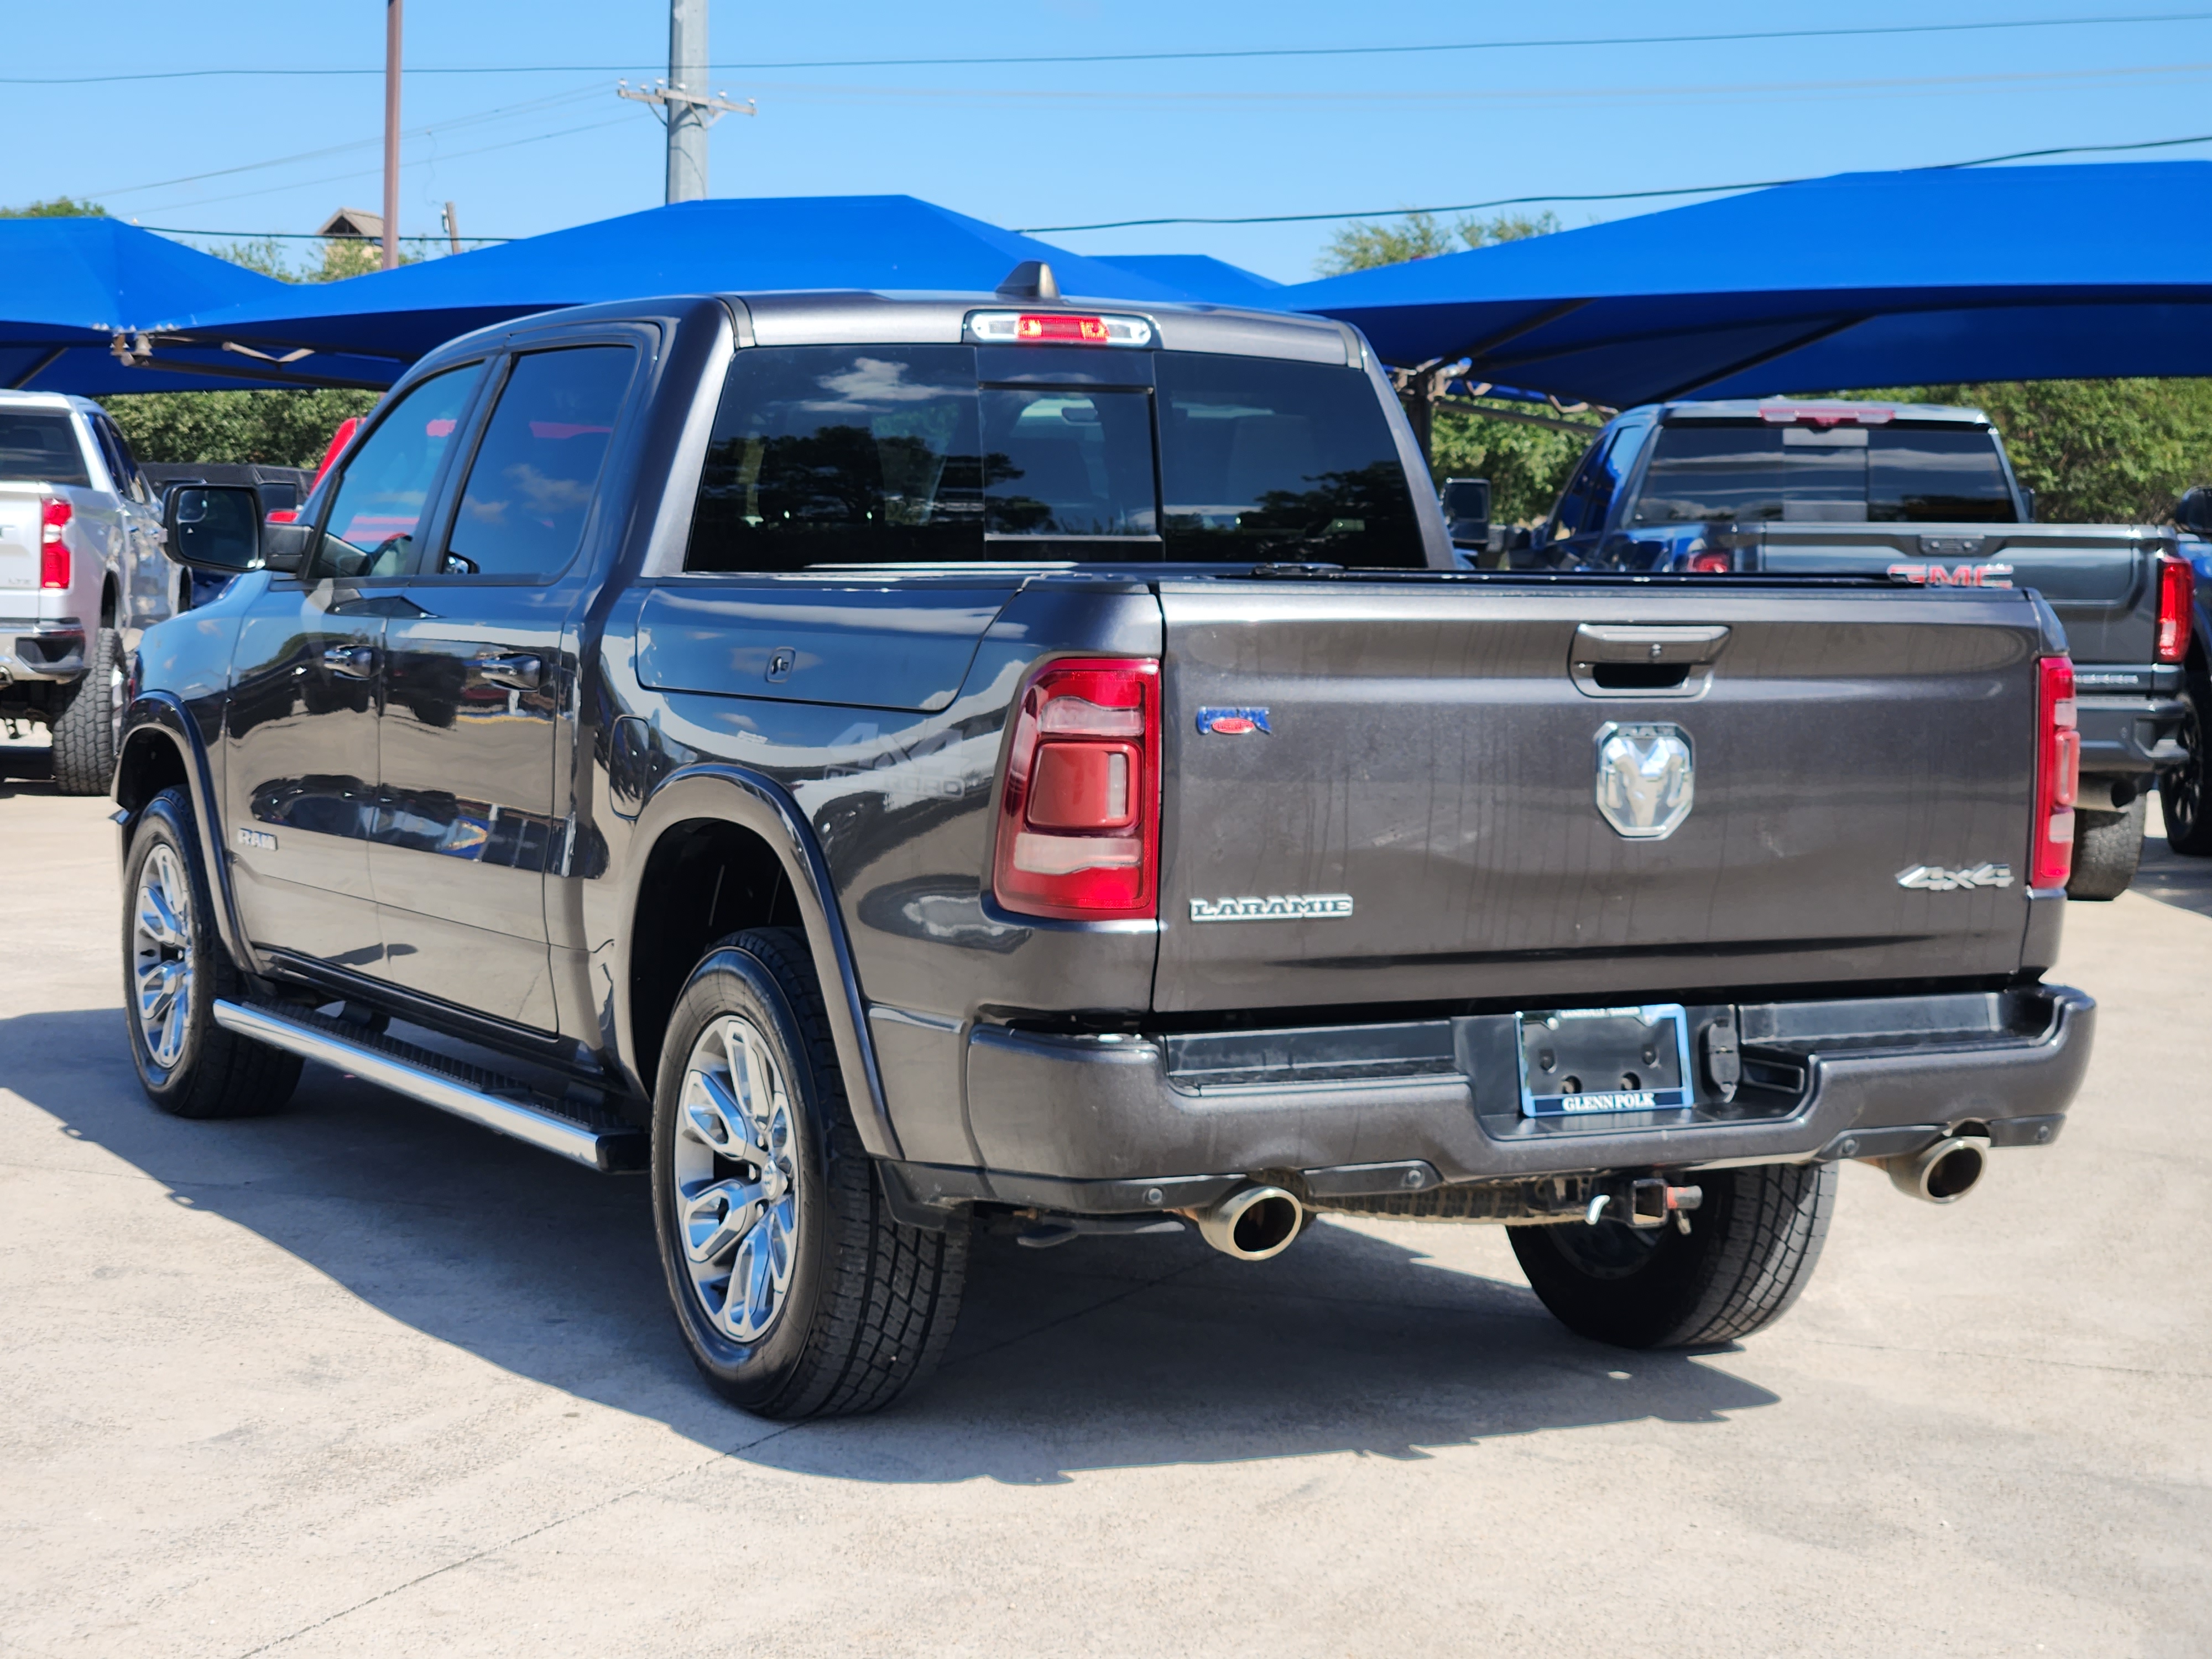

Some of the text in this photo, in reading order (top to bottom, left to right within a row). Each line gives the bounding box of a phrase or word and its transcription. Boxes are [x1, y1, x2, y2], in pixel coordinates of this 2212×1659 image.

[1887, 564, 2013, 589] GMC
[237, 828, 278, 851] RAM
[1191, 895, 1353, 920] LARAMIE
[1562, 1093, 1656, 1112] GLENN POLK
